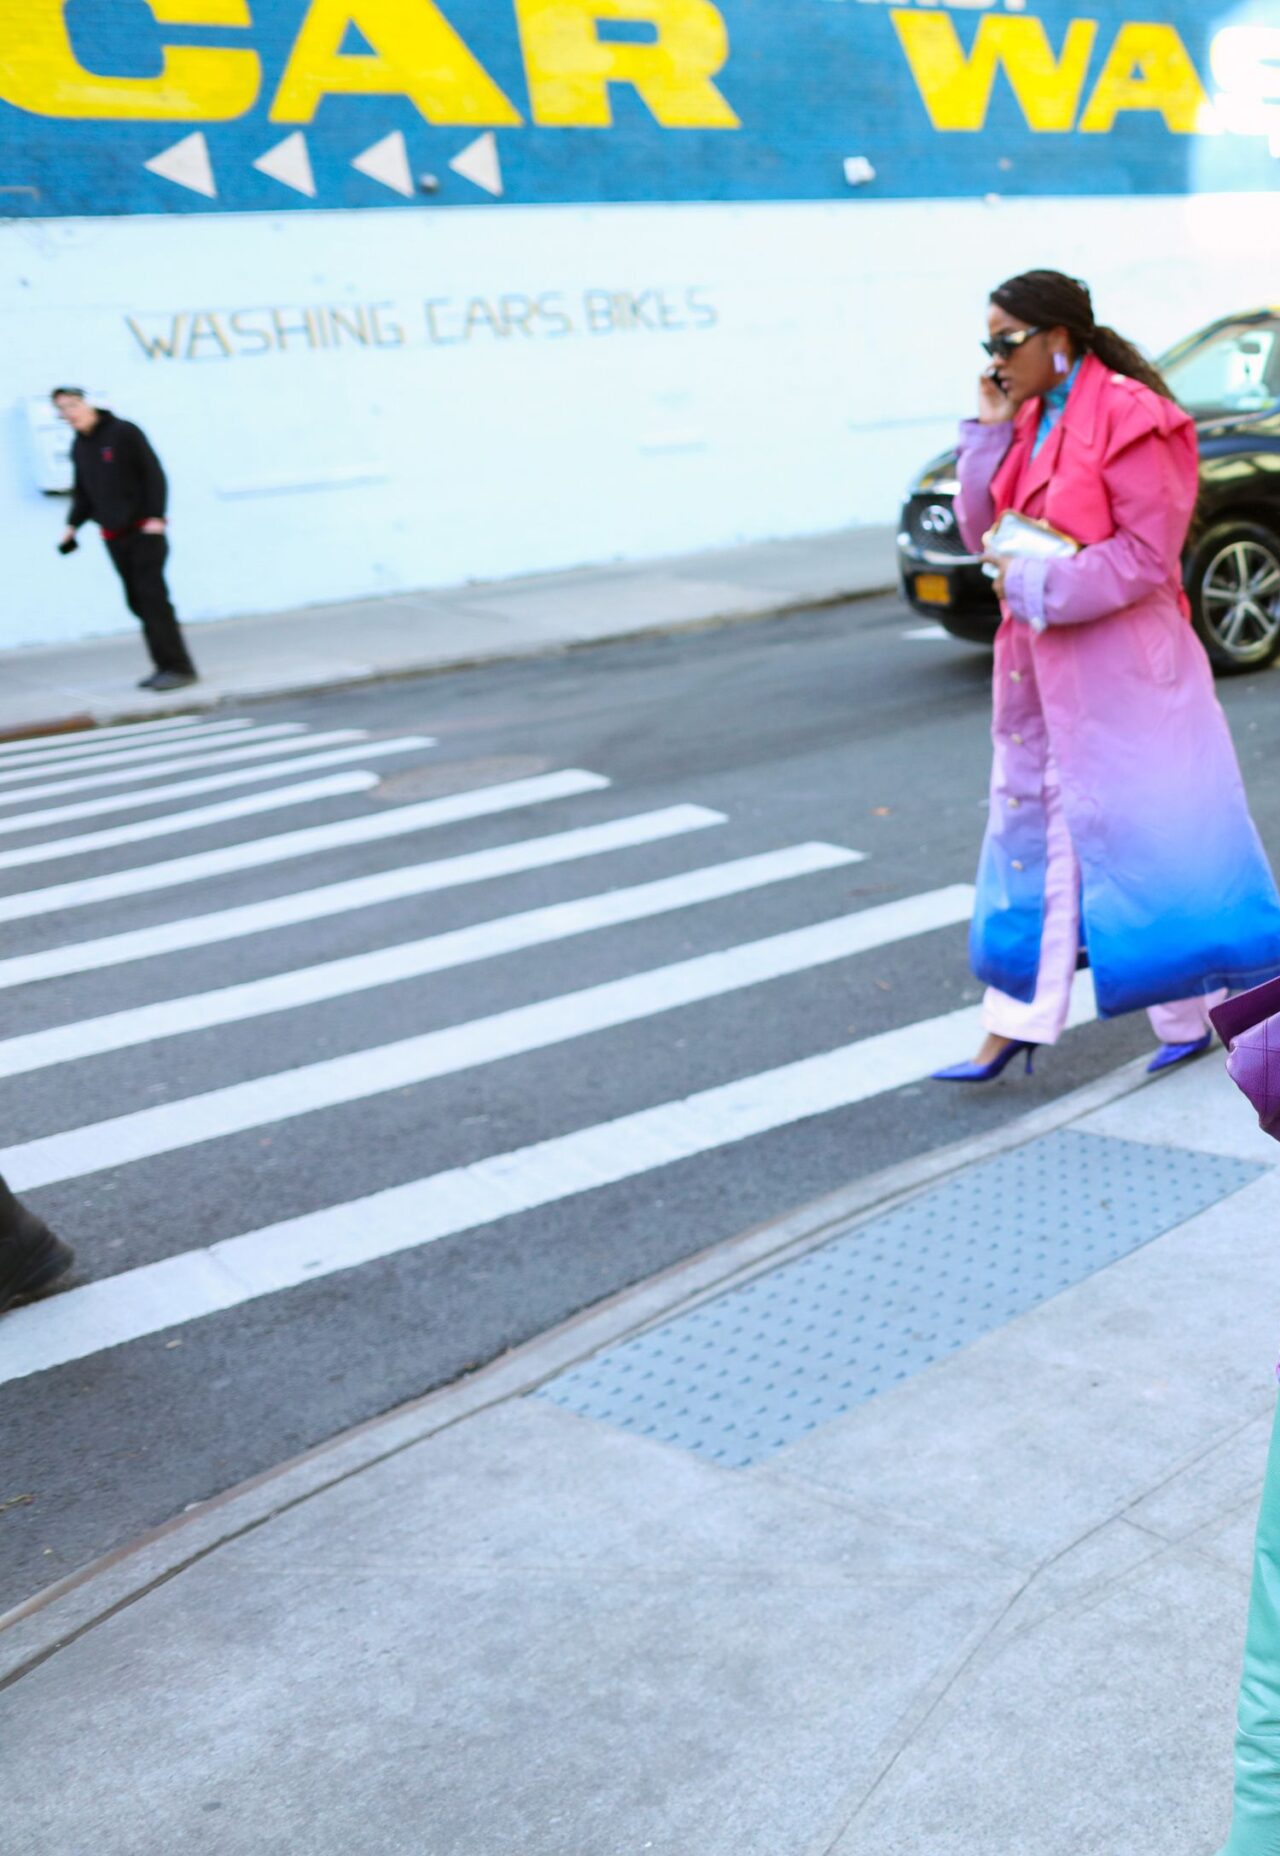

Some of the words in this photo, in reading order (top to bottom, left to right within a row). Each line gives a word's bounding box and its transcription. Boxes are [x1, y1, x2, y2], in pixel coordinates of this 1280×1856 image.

[0, 0, 741, 129] CAR
[124, 300, 405, 361] WASHING
[583, 286, 719, 336] BIKES
